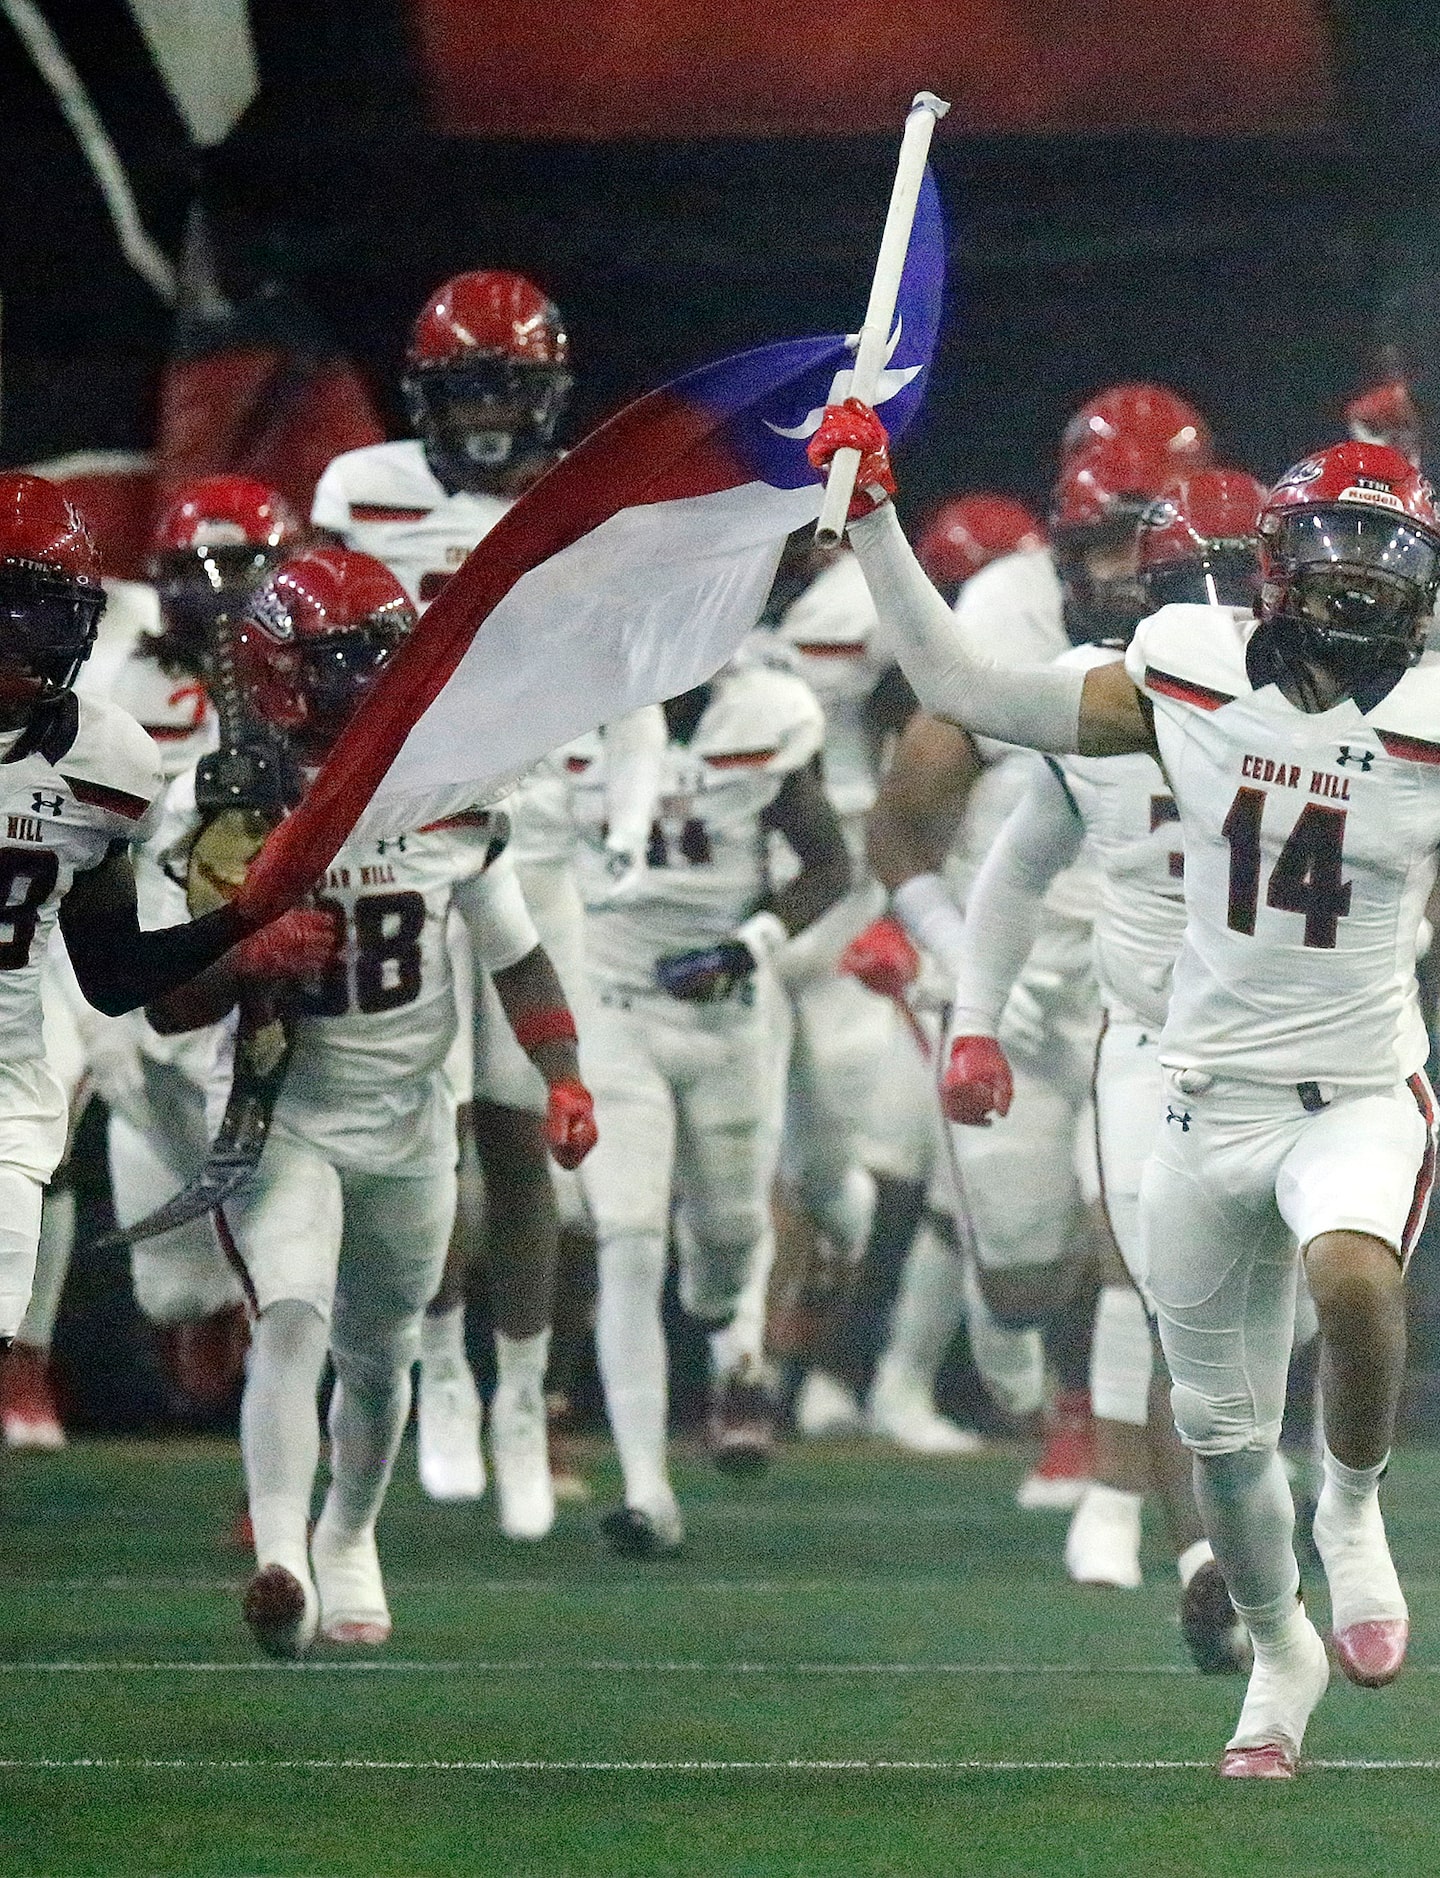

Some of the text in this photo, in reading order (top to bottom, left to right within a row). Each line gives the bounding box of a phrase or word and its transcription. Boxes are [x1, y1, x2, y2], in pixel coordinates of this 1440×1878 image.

[1241, 754, 1351, 801] CEDAR HILL
[6, 815, 43, 843] HILL
[360, 864, 396, 886] HILL
[1221, 785, 1353, 949] 14
